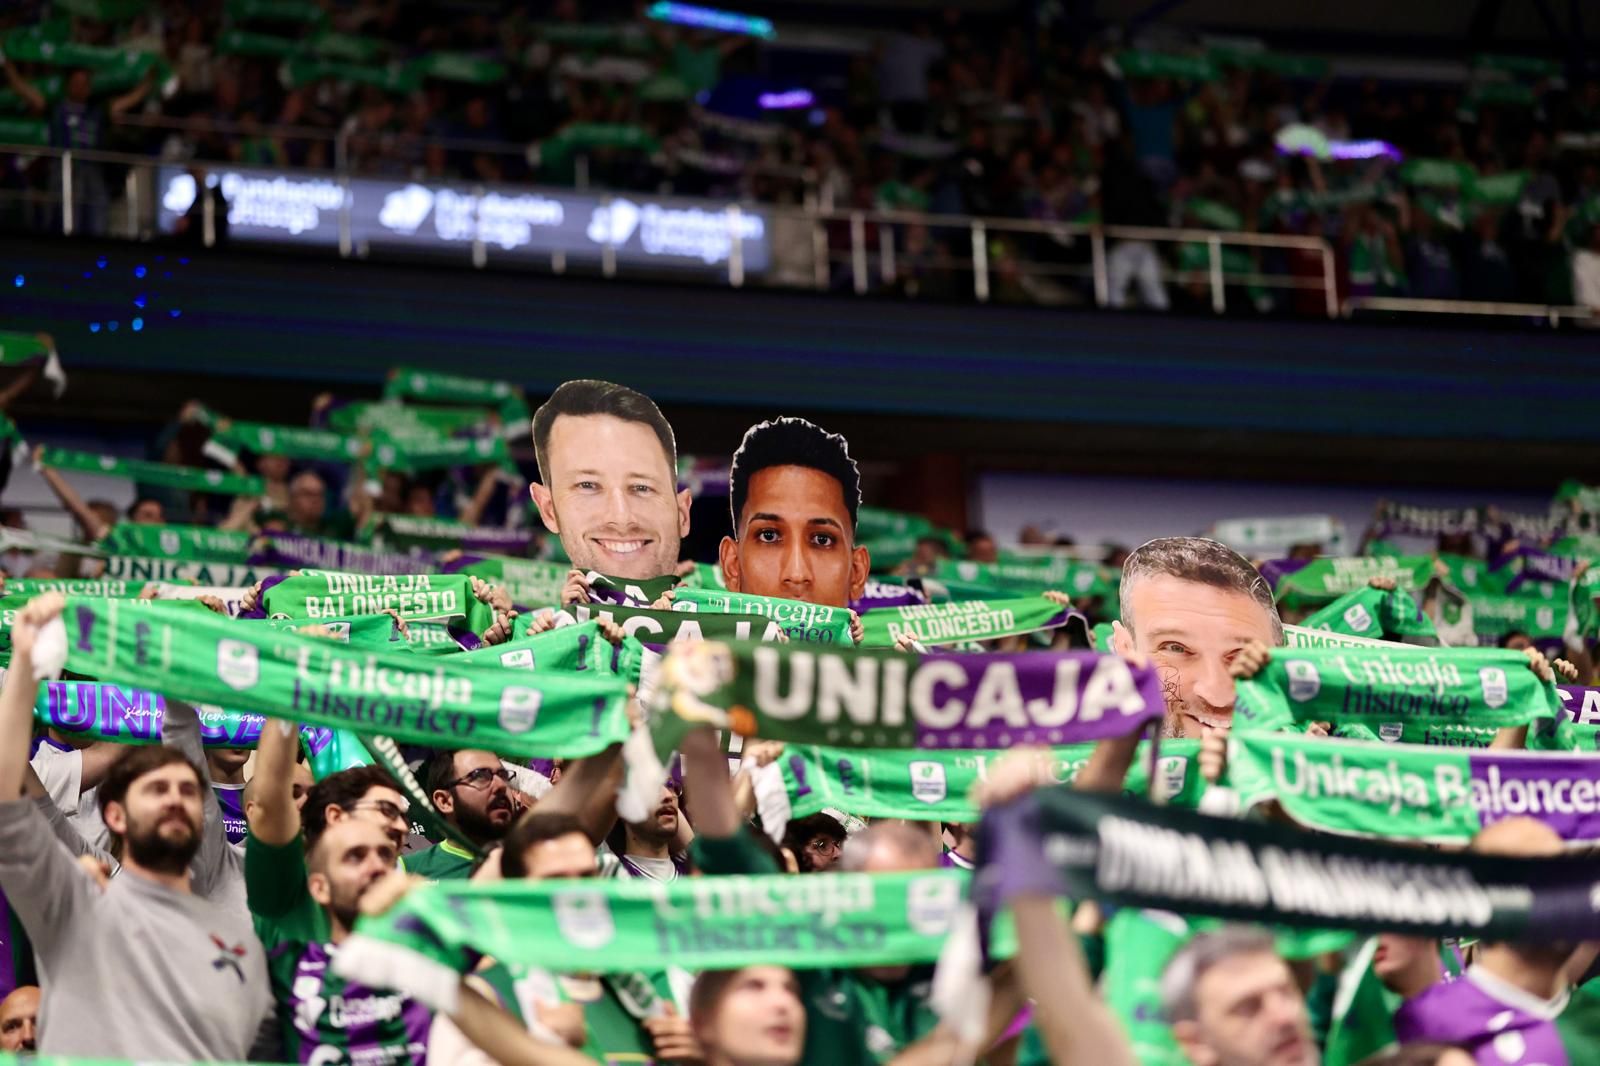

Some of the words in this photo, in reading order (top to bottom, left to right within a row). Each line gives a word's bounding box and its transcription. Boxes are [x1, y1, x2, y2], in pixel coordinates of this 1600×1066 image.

[887, 608, 1015, 642] BALONCESTO
[752, 645, 1147, 730] UNICAJA
[1334, 653, 1462, 696] Unicaja
[1272, 746, 1430, 816] Unicaja
